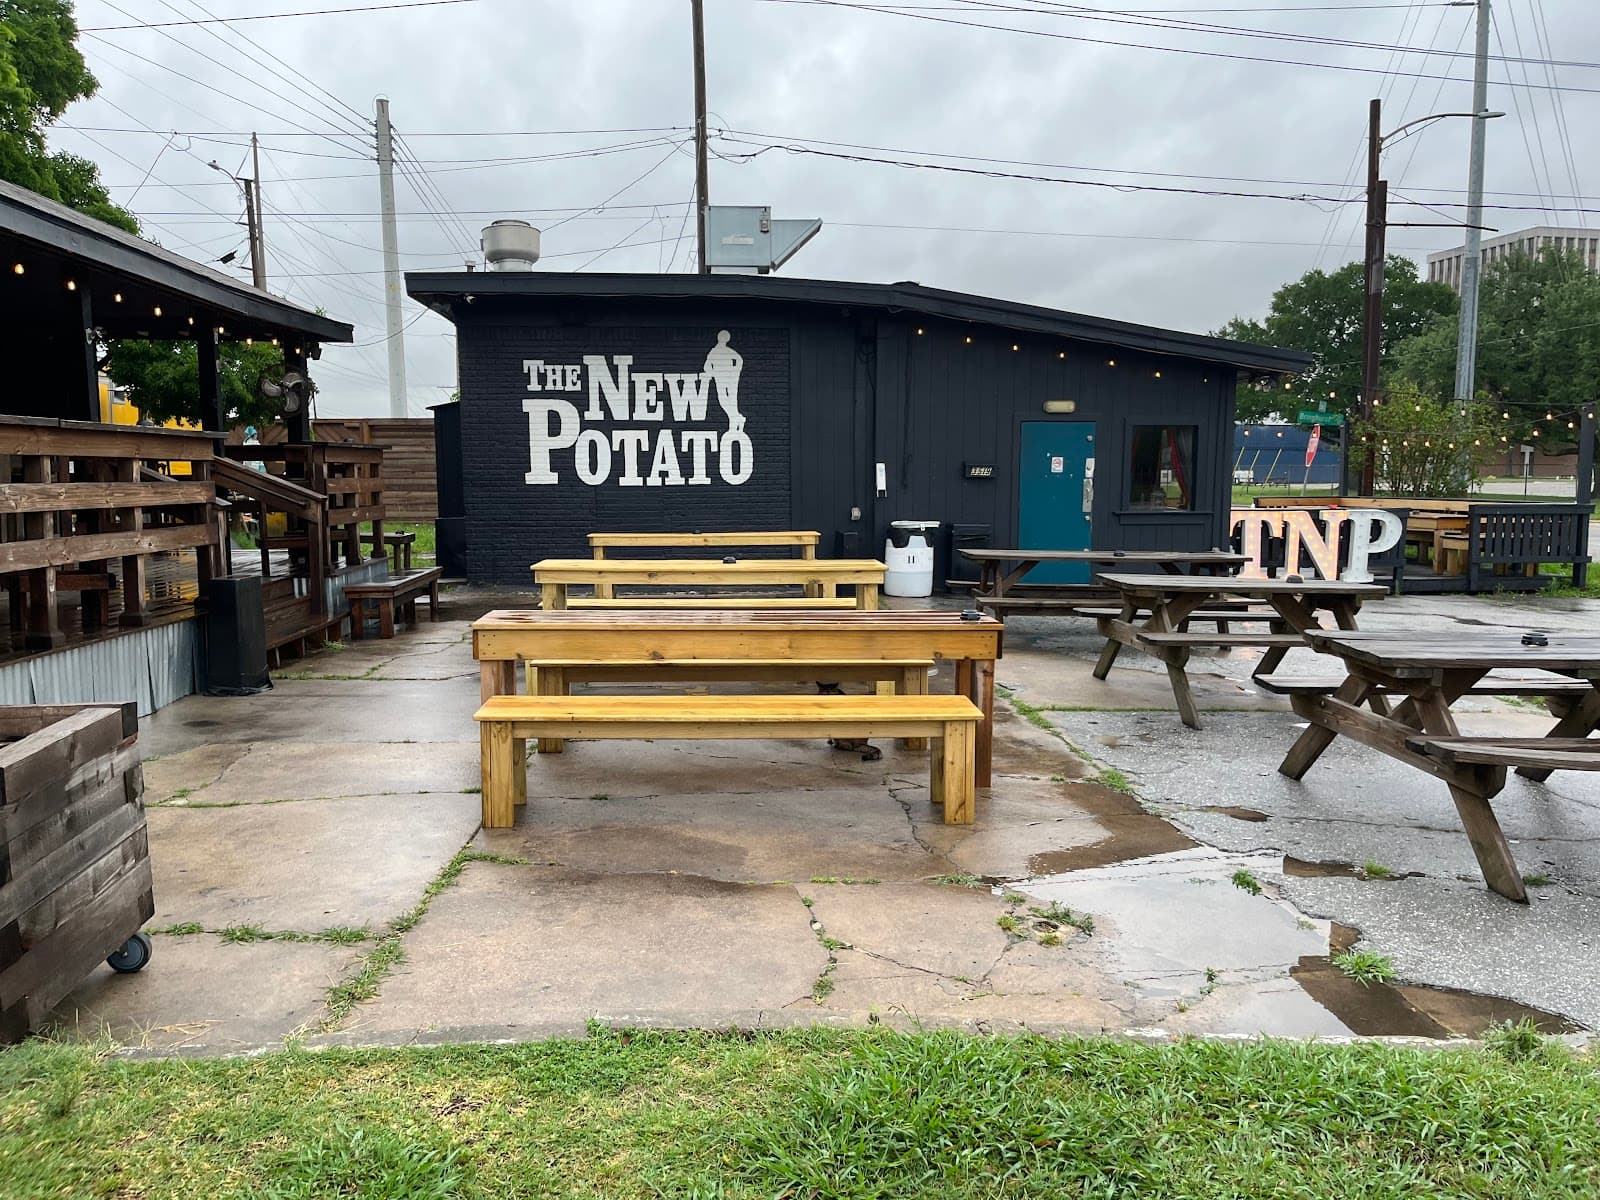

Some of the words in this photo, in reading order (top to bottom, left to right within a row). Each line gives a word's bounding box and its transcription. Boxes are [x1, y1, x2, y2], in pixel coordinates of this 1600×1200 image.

[523, 360, 581, 391] THE
[583, 355, 712, 421] NEW
[522, 399, 753, 486] POTATO
[1230, 509, 1403, 583] TNP
